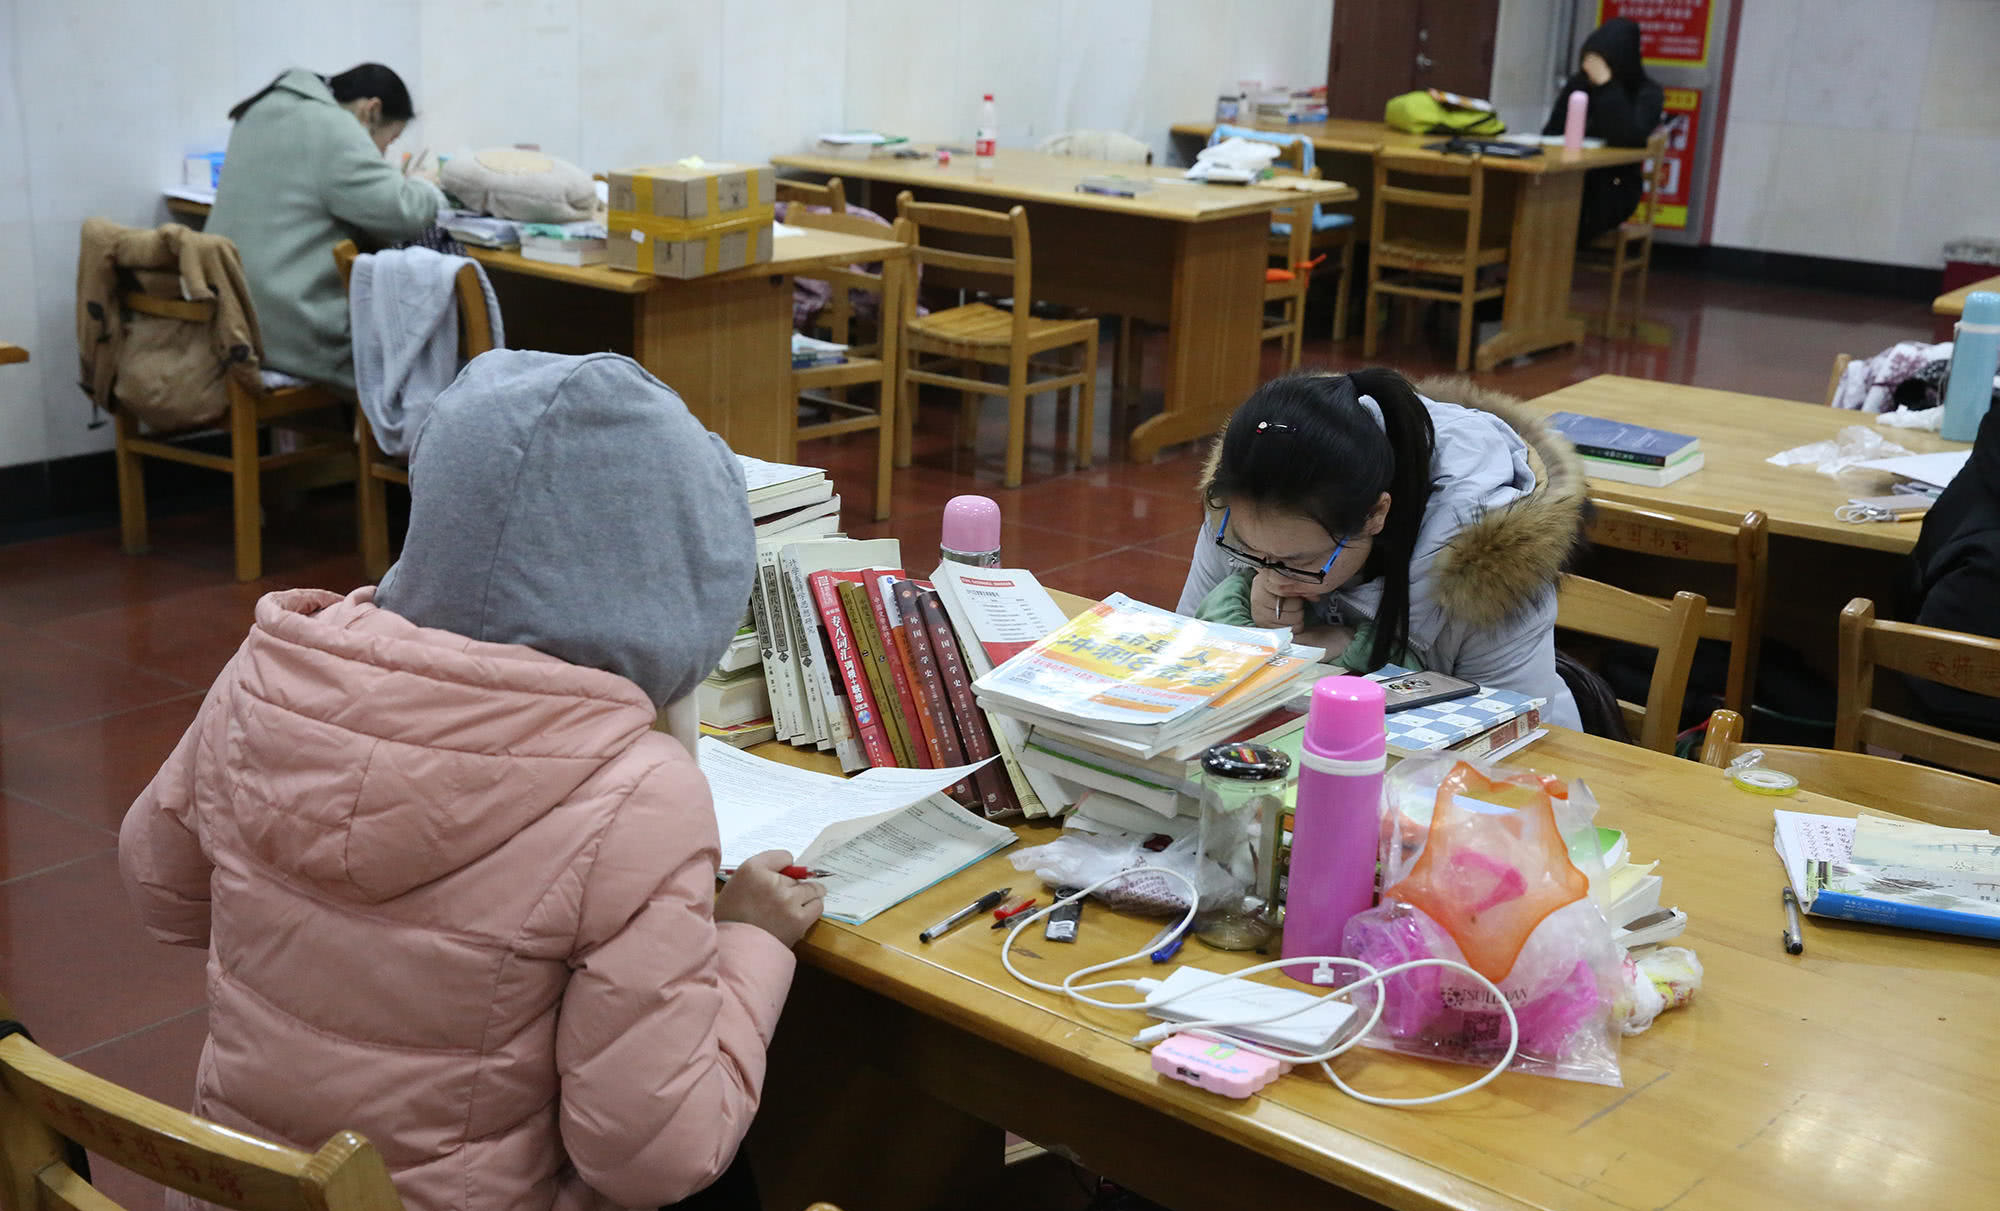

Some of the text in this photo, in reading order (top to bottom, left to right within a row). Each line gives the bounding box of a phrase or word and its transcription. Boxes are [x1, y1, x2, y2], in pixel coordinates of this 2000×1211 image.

[831, 616, 853, 661] 专八词汇
[908, 615, 935, 680] 外国文学史
[936, 625, 963, 689] 外国文学史
